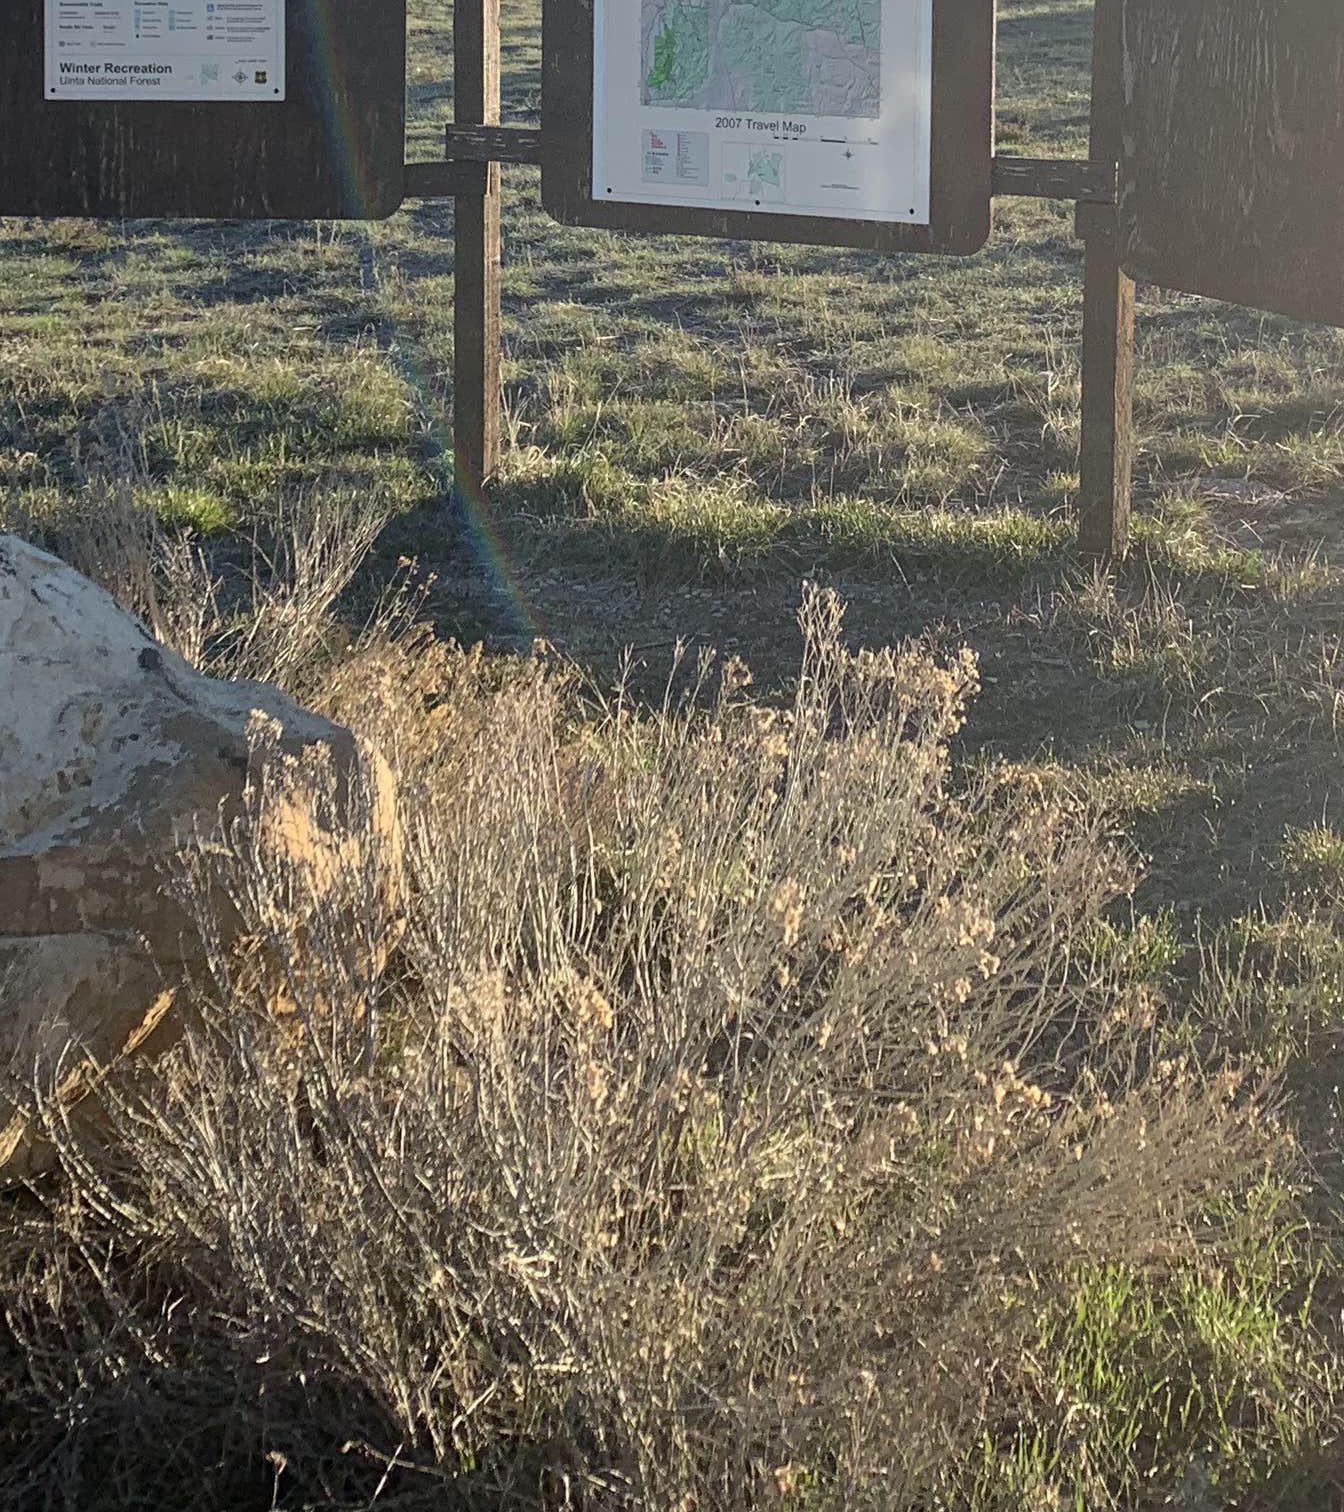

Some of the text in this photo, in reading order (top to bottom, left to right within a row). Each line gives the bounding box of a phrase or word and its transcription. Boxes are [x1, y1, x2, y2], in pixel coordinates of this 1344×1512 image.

[59, 62, 173, 74] Winter Recreation
[87, 76, 128, 86] National
[129, 76, 161, 86] Forest
[715, 117, 807, 135] 2007 Travel Map
